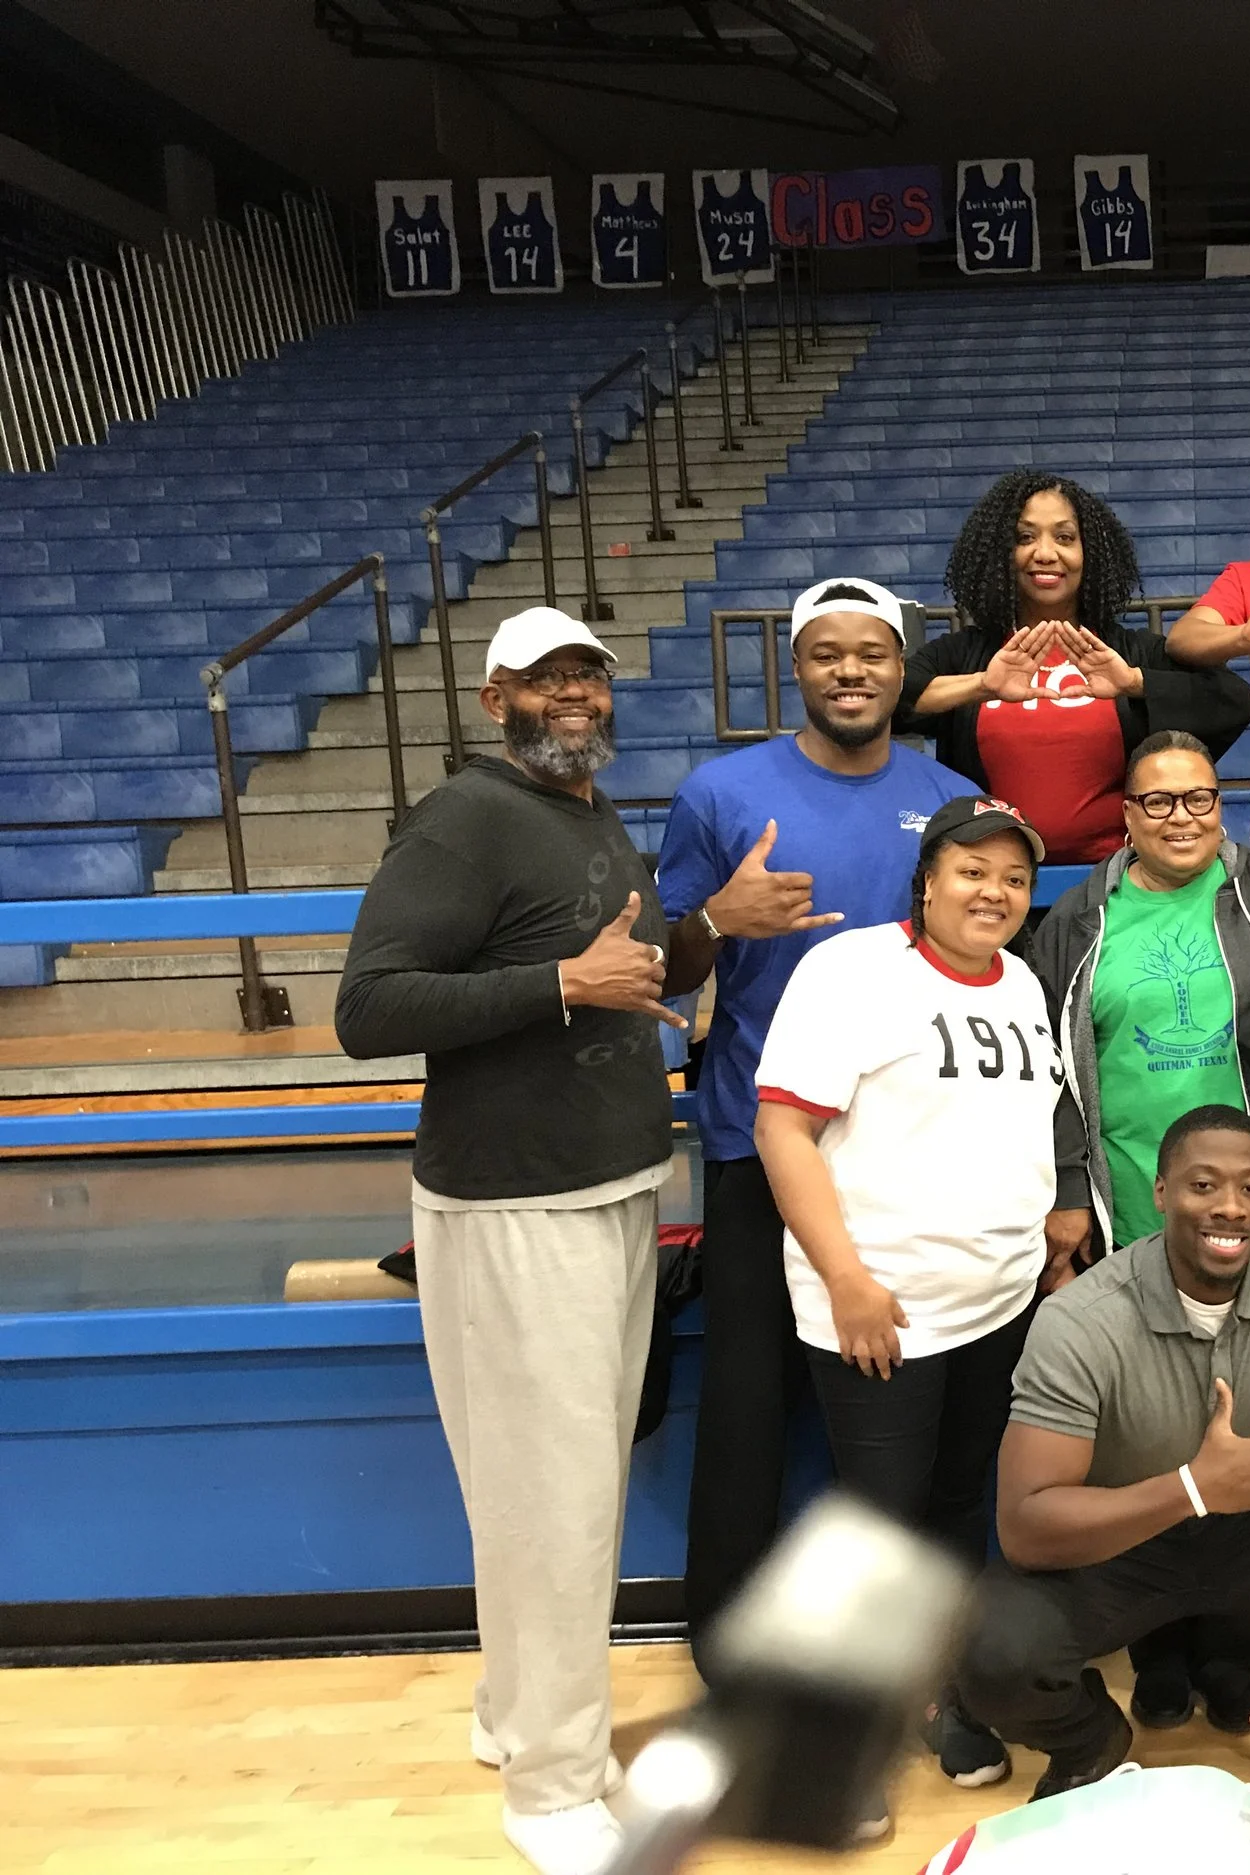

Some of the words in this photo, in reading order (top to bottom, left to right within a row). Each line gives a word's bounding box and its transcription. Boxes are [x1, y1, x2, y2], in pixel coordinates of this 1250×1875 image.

[710, 209, 755, 225] Musa
[772, 174, 934, 248] Class
[1091, 198, 1135, 216] Gibbs
[394, 227, 440, 246] Salat
[717, 230, 754, 261] 24
[971, 220, 1017, 261] 34
[1105, 220, 1132, 257] 14
[406, 248, 428, 287] 11
[504, 246, 538, 282] 14
[615, 235, 639, 279] 4
[1198, 1055, 1228, 1068] TEXAS
